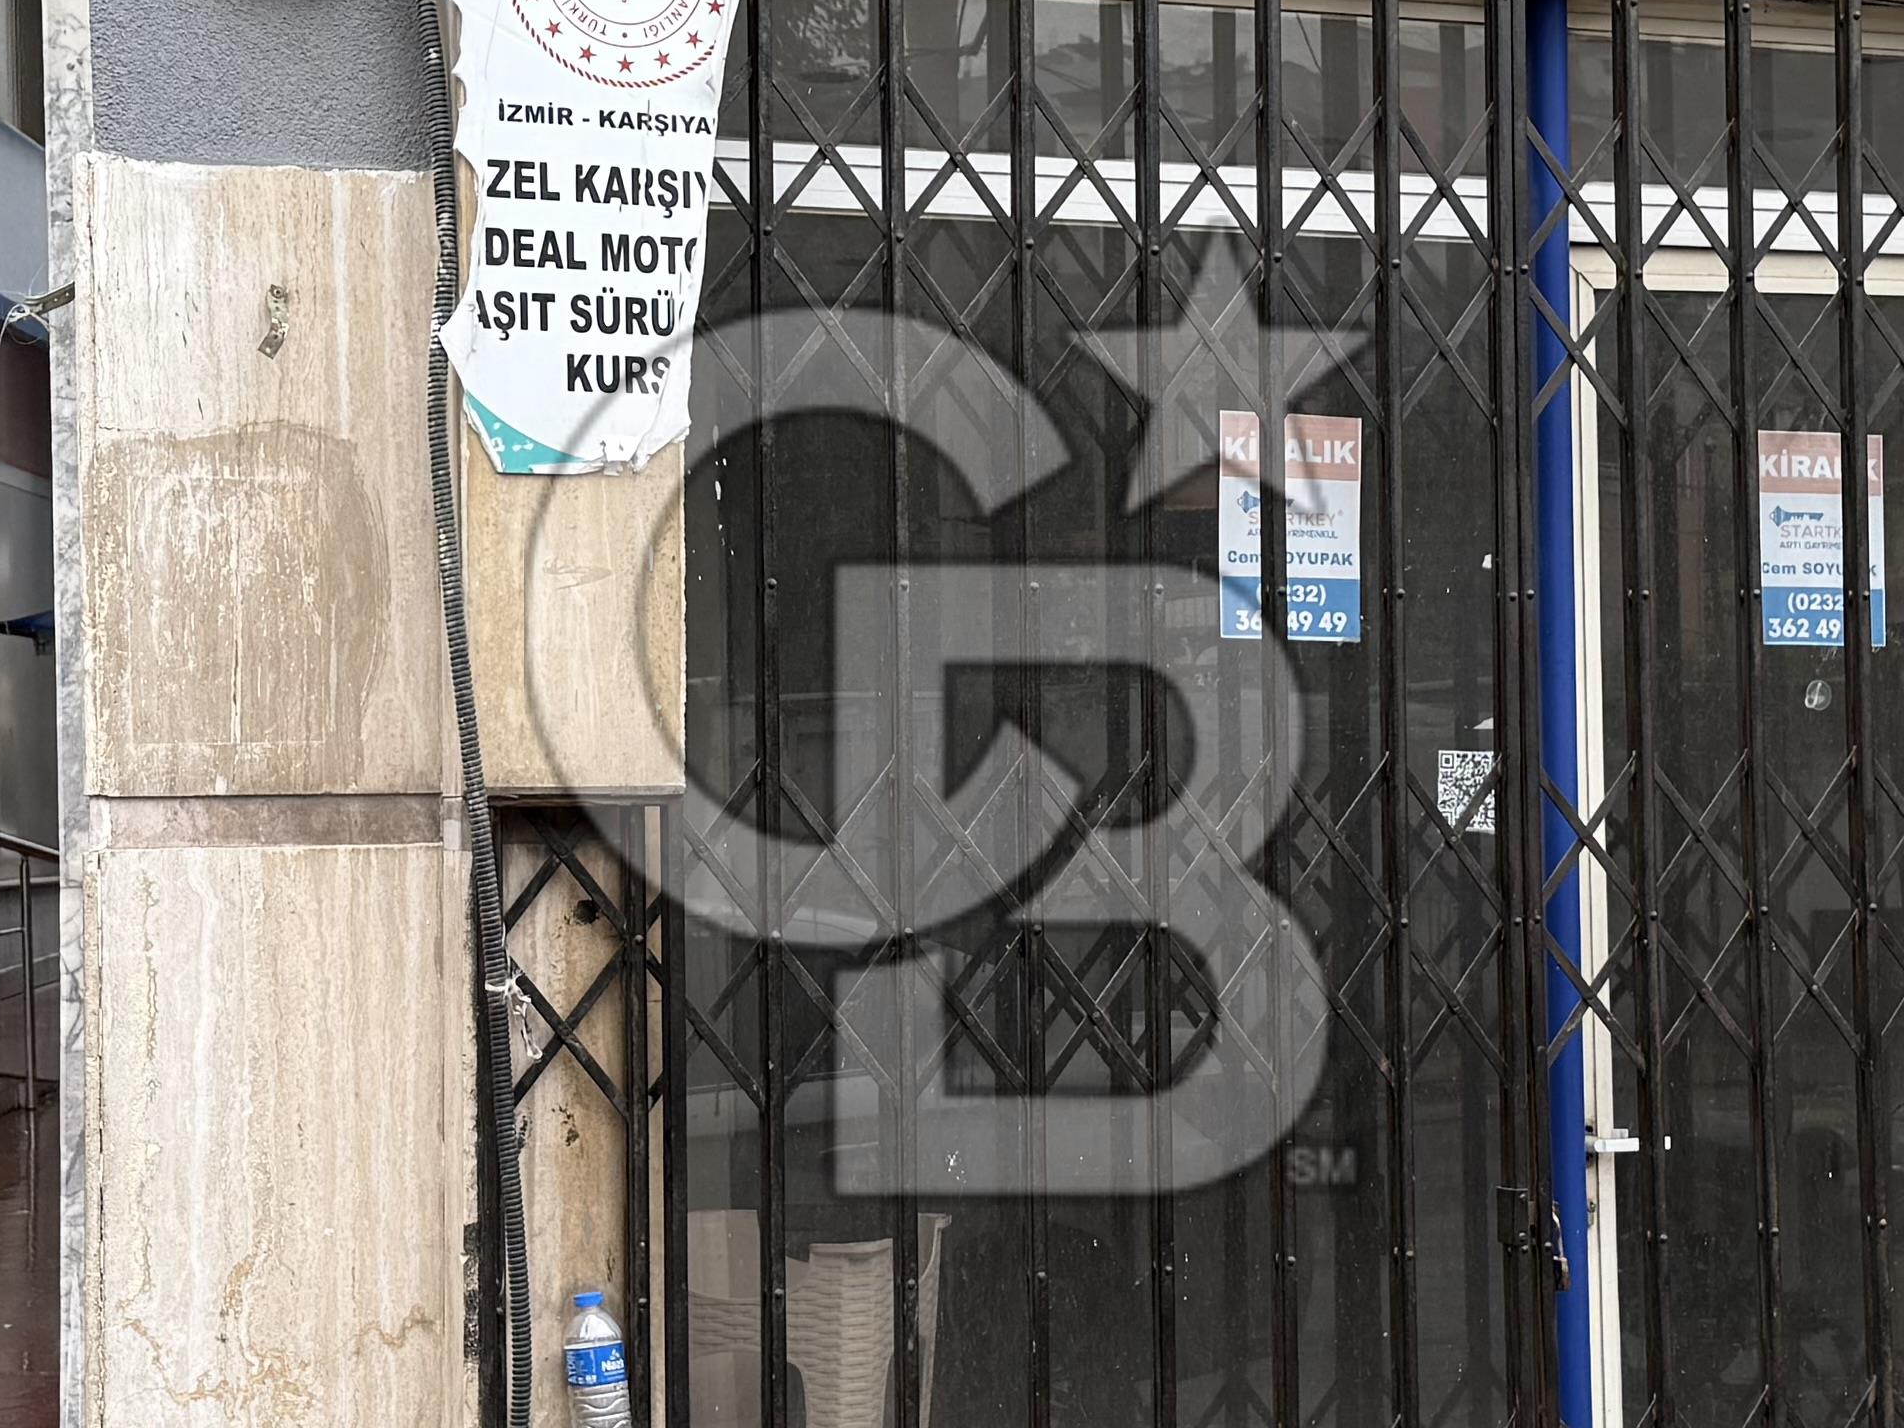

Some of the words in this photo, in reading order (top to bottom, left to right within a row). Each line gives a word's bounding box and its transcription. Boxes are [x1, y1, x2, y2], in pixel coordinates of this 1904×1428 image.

[498, 98, 574, 126] İZMİR
[599, 109, 714, 137] KARŞIYA
[487, 159, 560, 201] ZEL
[485, 227, 587, 270] DEAL
[570, 286, 684, 337] SÜRÜ
[1223, 430, 1357, 465] KİALIK
[1760, 448, 1879, 481] KİRAK
[1286, 550, 1354, 567] OYUPAK
[1787, 592, 1844, 614] (0232
[1234, 609, 1262, 631] 36
[1319, 611, 1348, 634] 49
[1768, 617, 1810, 639] 362
